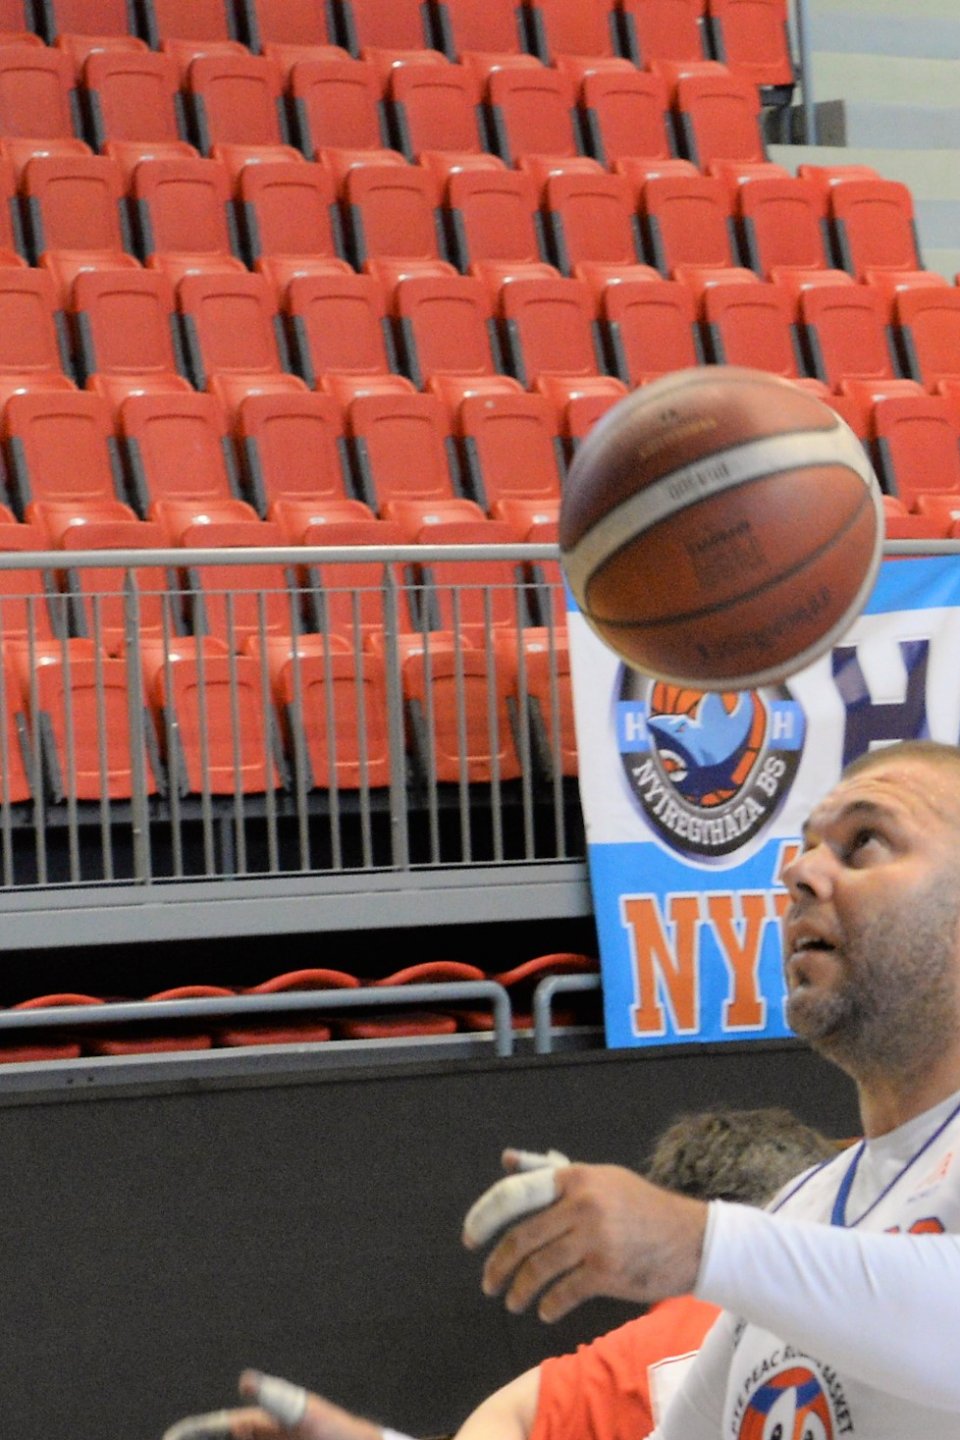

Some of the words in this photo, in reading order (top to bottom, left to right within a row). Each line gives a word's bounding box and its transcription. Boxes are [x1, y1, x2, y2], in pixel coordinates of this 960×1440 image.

[625, 713, 646, 741] H
[772, 711, 793, 739] H
[756, 756, 786, 797] BS
